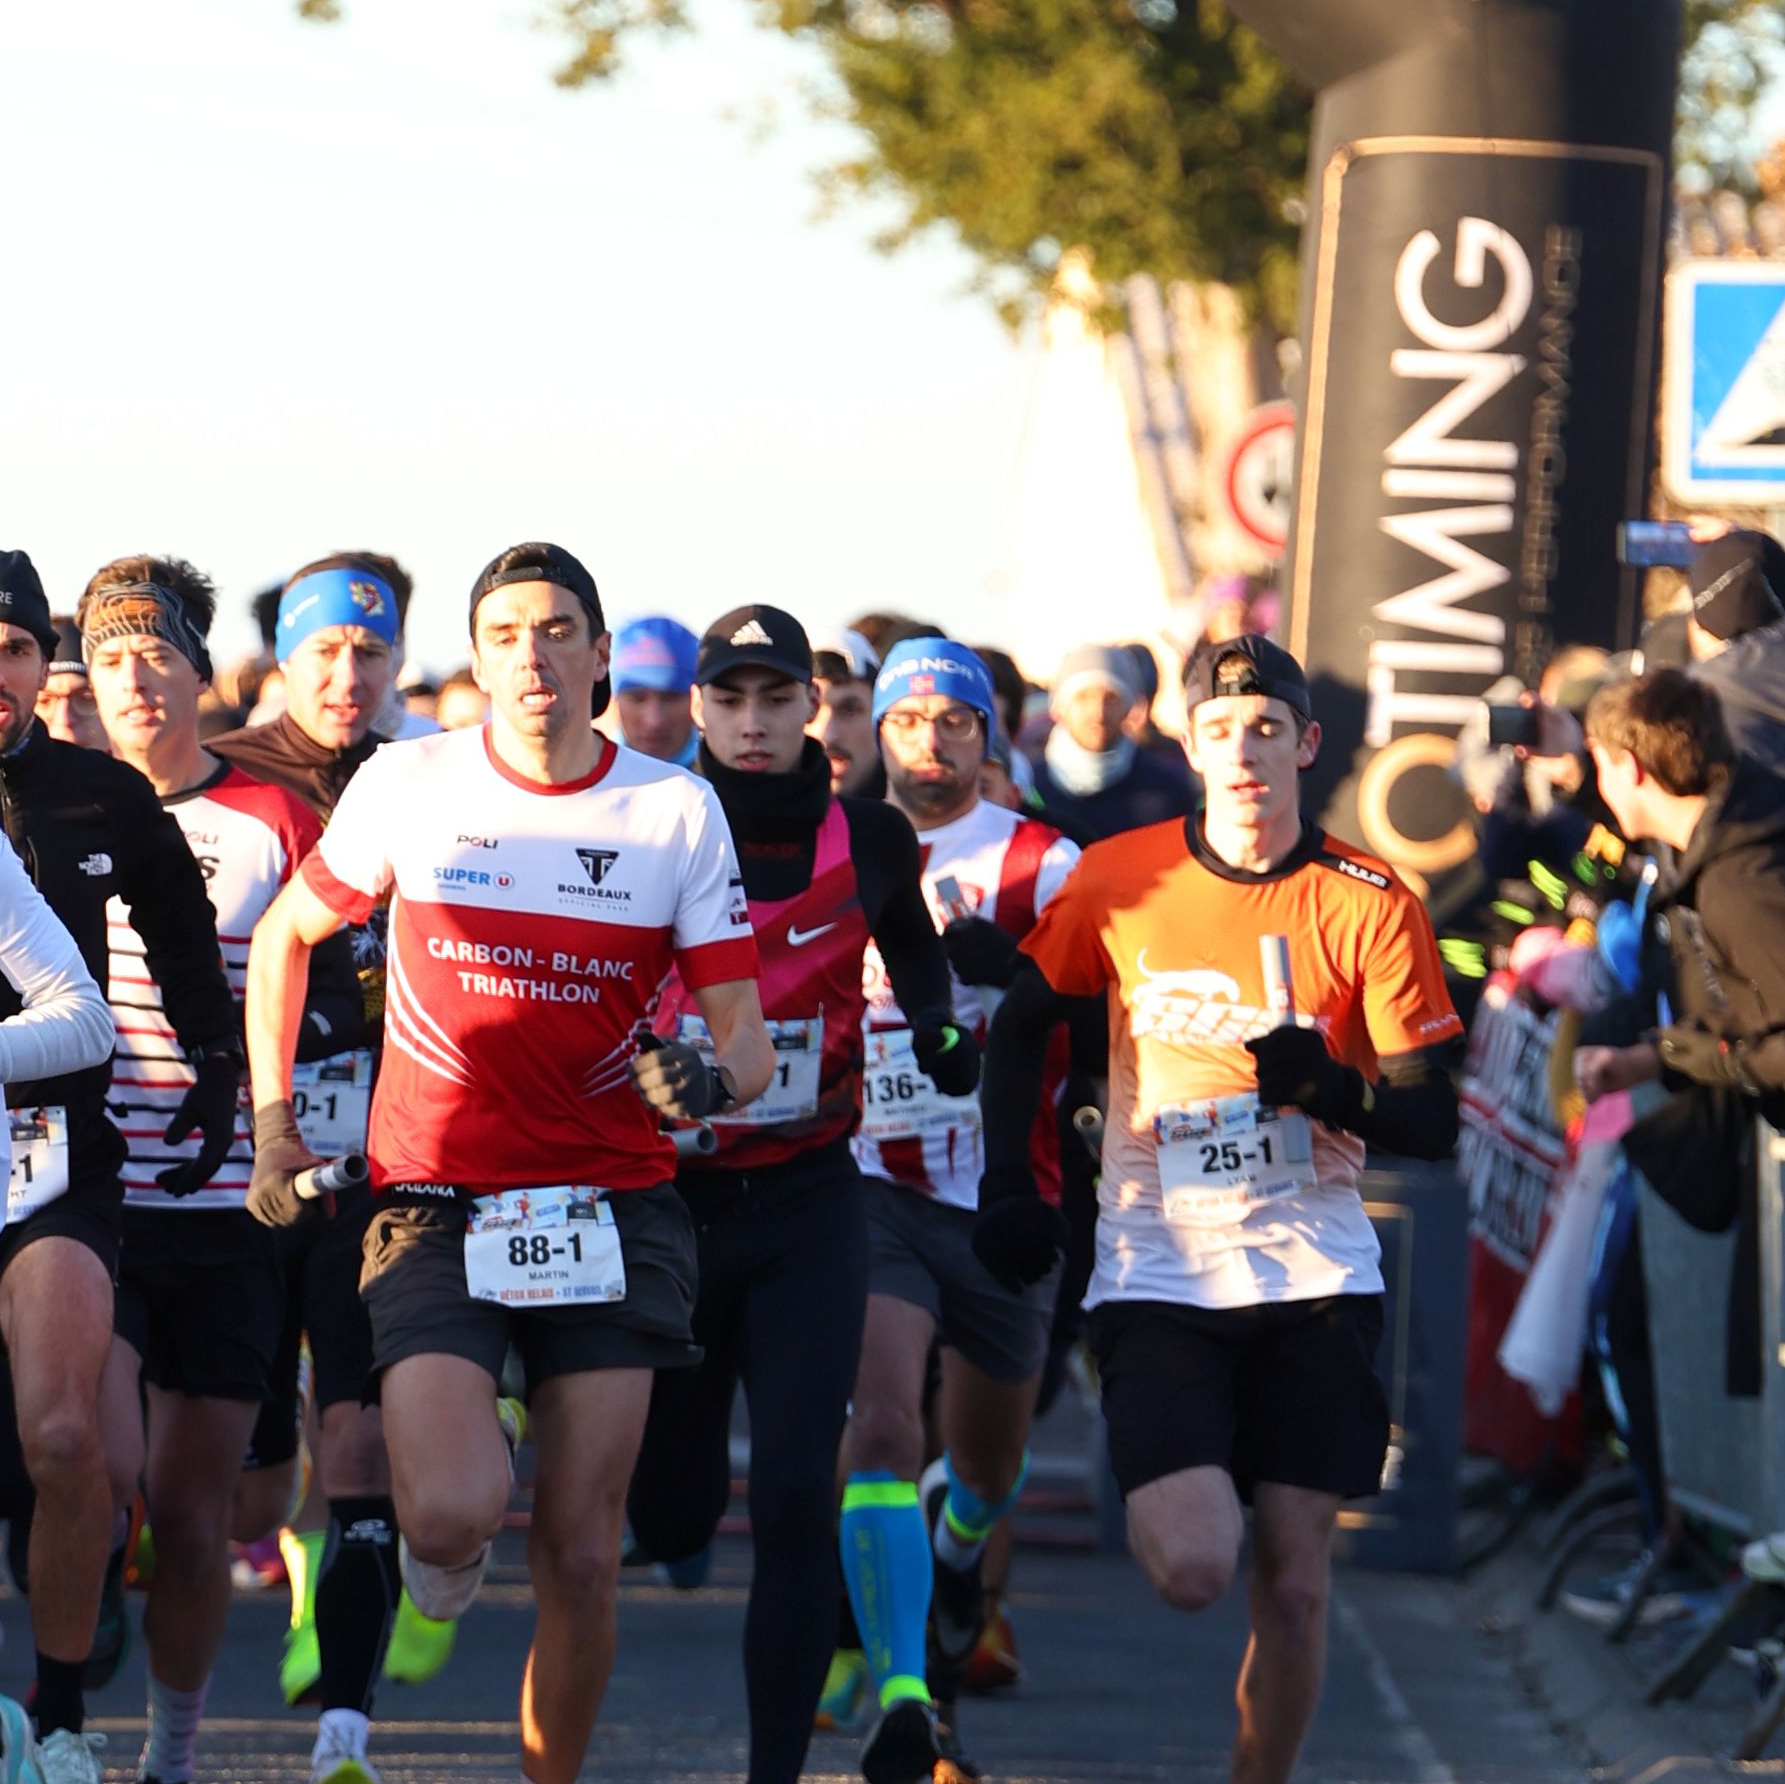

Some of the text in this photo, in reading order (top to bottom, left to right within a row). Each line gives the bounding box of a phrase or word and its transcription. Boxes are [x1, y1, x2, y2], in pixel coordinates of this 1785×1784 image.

[1357, 216, 1534, 873] OTIMING
[186, 831, 219, 844] OLI
[456, 834, 499, 850] POLI
[433, 866, 491, 885] SUPER
[557, 884, 632, 901] BORDEAUX
[427, 937, 533, 967] CARBON
[552, 951, 634, 980] BLANC
[457, 971, 600, 1004] TRIATHLON
[864, 1072, 927, 1105] 136-
[293, 1090, 336, 1120] 0-1
[1199, 1135, 1273, 1173] 25-1
[508, 1232, 582, 1266] 88-1
[528, 1270, 569, 1280] MARTIN
